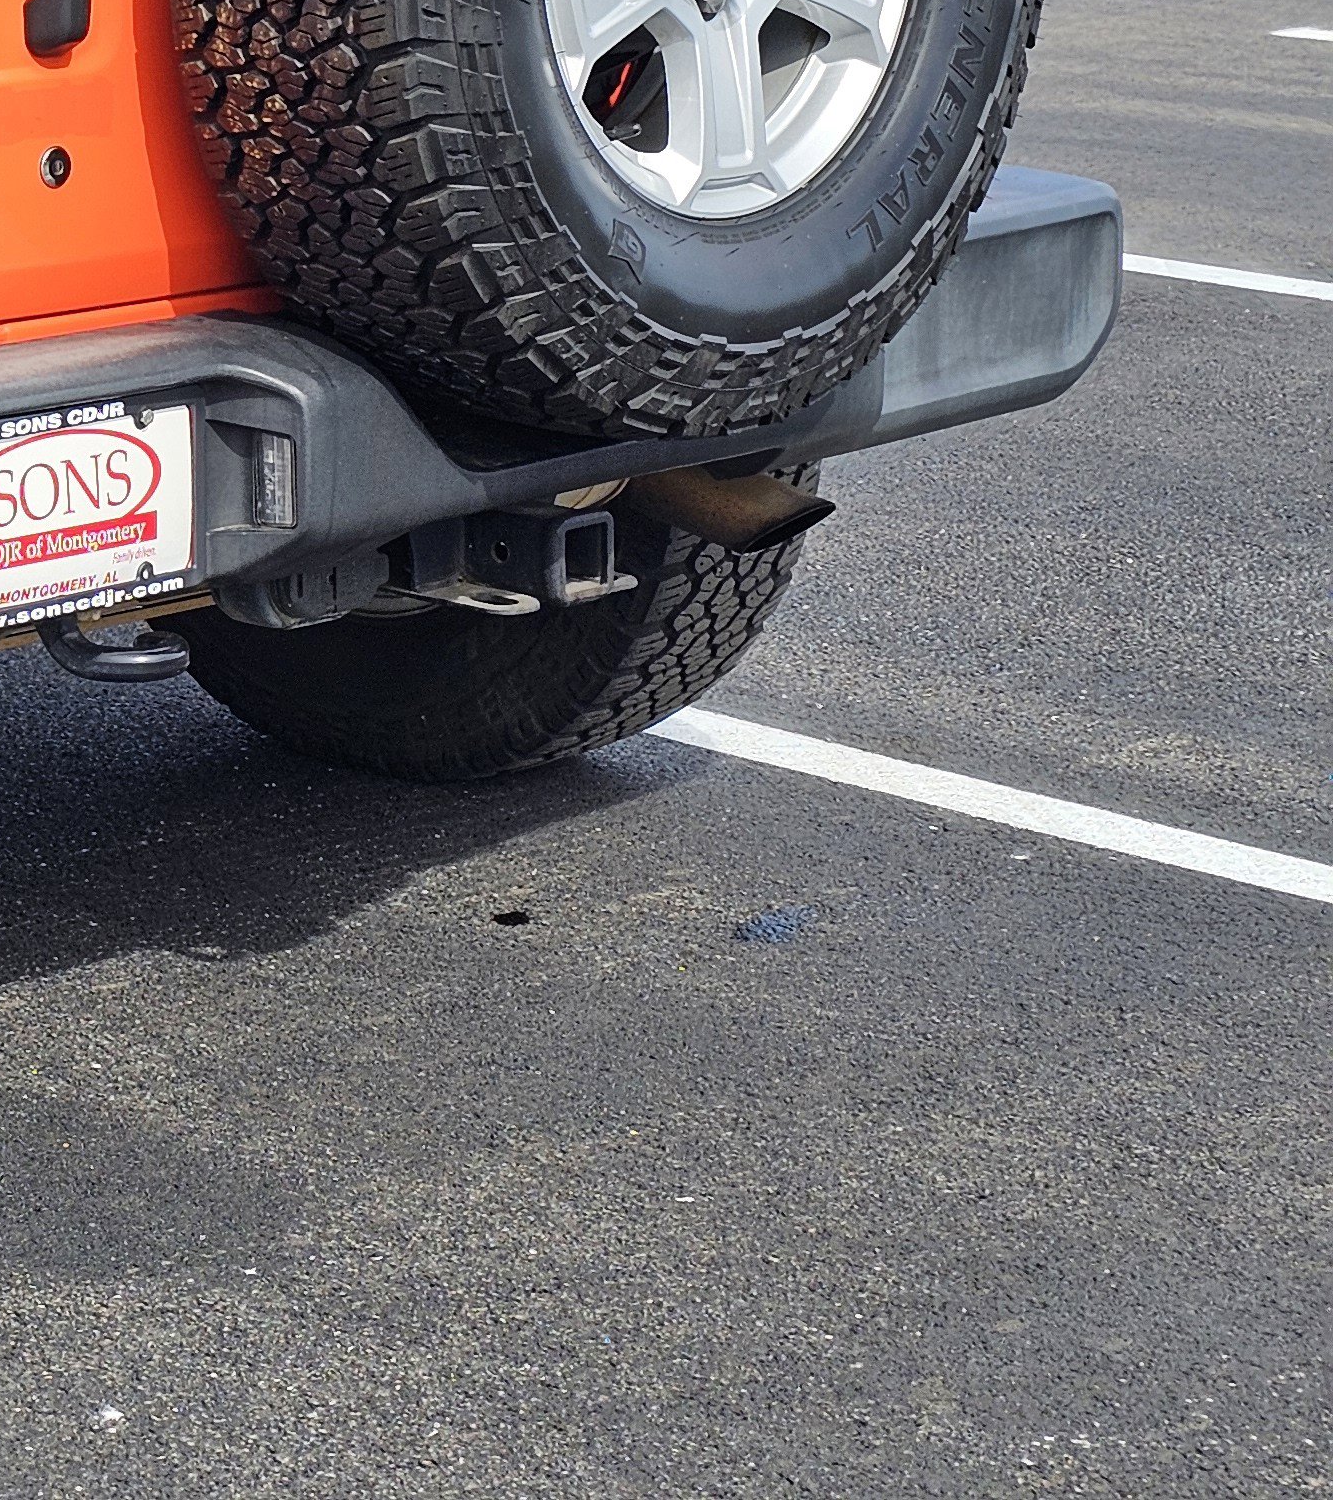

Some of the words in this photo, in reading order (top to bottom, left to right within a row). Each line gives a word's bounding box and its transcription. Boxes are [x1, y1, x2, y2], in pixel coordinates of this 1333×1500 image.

[0, 411, 62, 438] SONS
[66, 401, 125, 426] CDJR
[25, 535, 44, 560] of
[44, 520, 147, 554] Montgomery
[102, 570, 119, 585] AL
